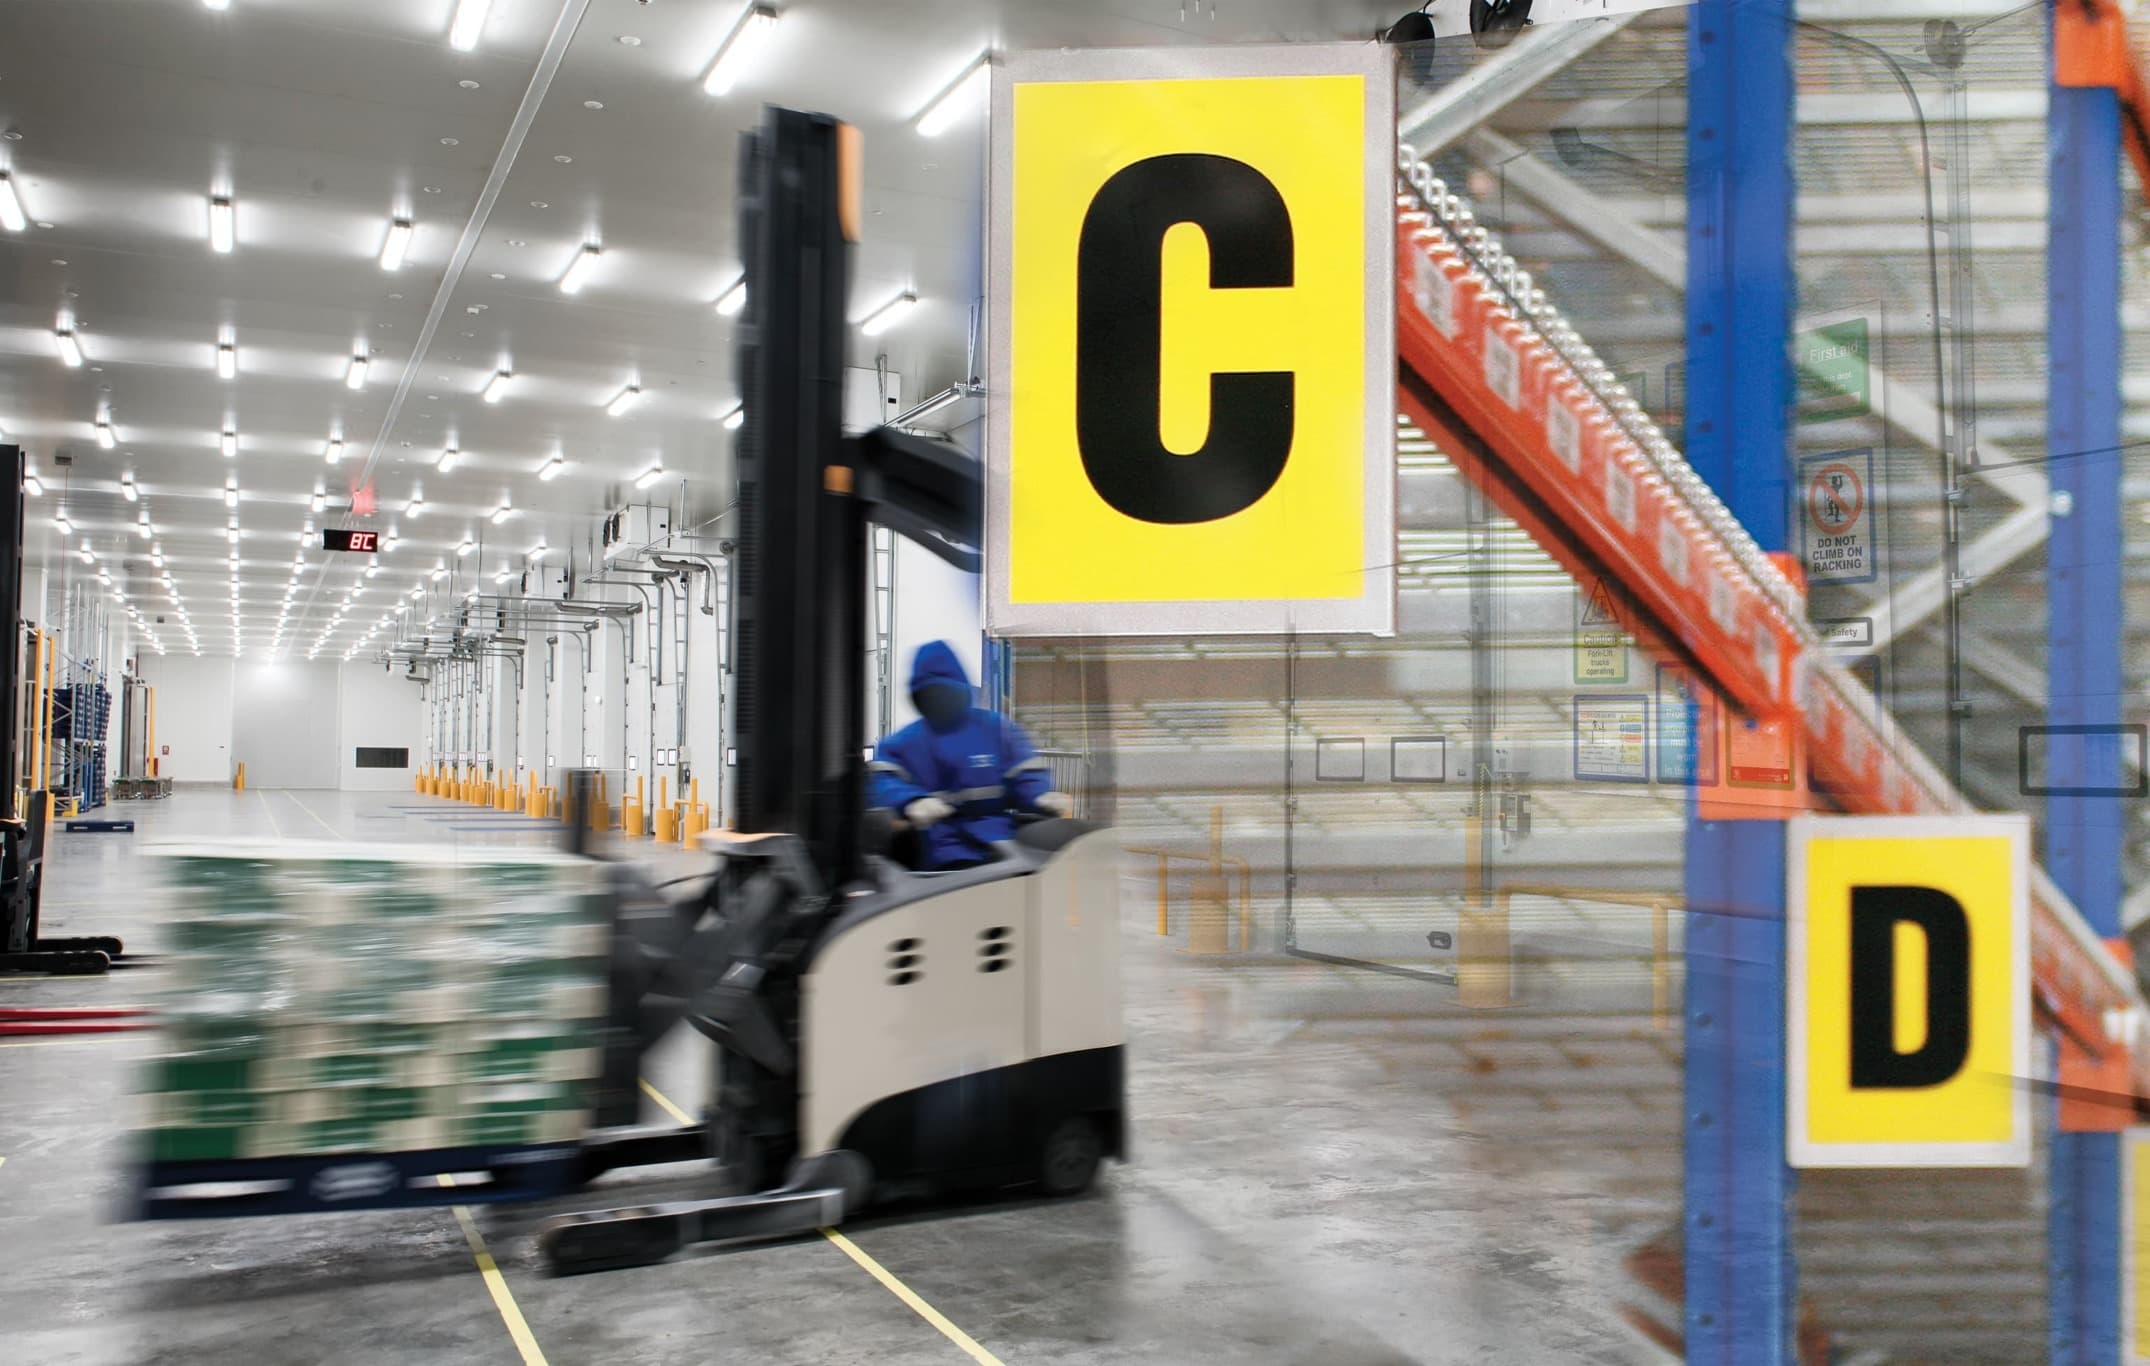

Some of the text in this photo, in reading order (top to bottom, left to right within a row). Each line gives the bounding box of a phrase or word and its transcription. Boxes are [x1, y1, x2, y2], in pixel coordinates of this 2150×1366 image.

[1076, 153, 1294, 525] C
[1810, 338, 1858, 361] First aid
[1818, 536, 1857, 548] DO NOT
[1813, 547, 1862, 560] CLIMB ON
[1813, 559, 1862, 573] RACKING
[1831, 627, 1858, 638] Safety
[1849, 885, 1972, 1090] D
